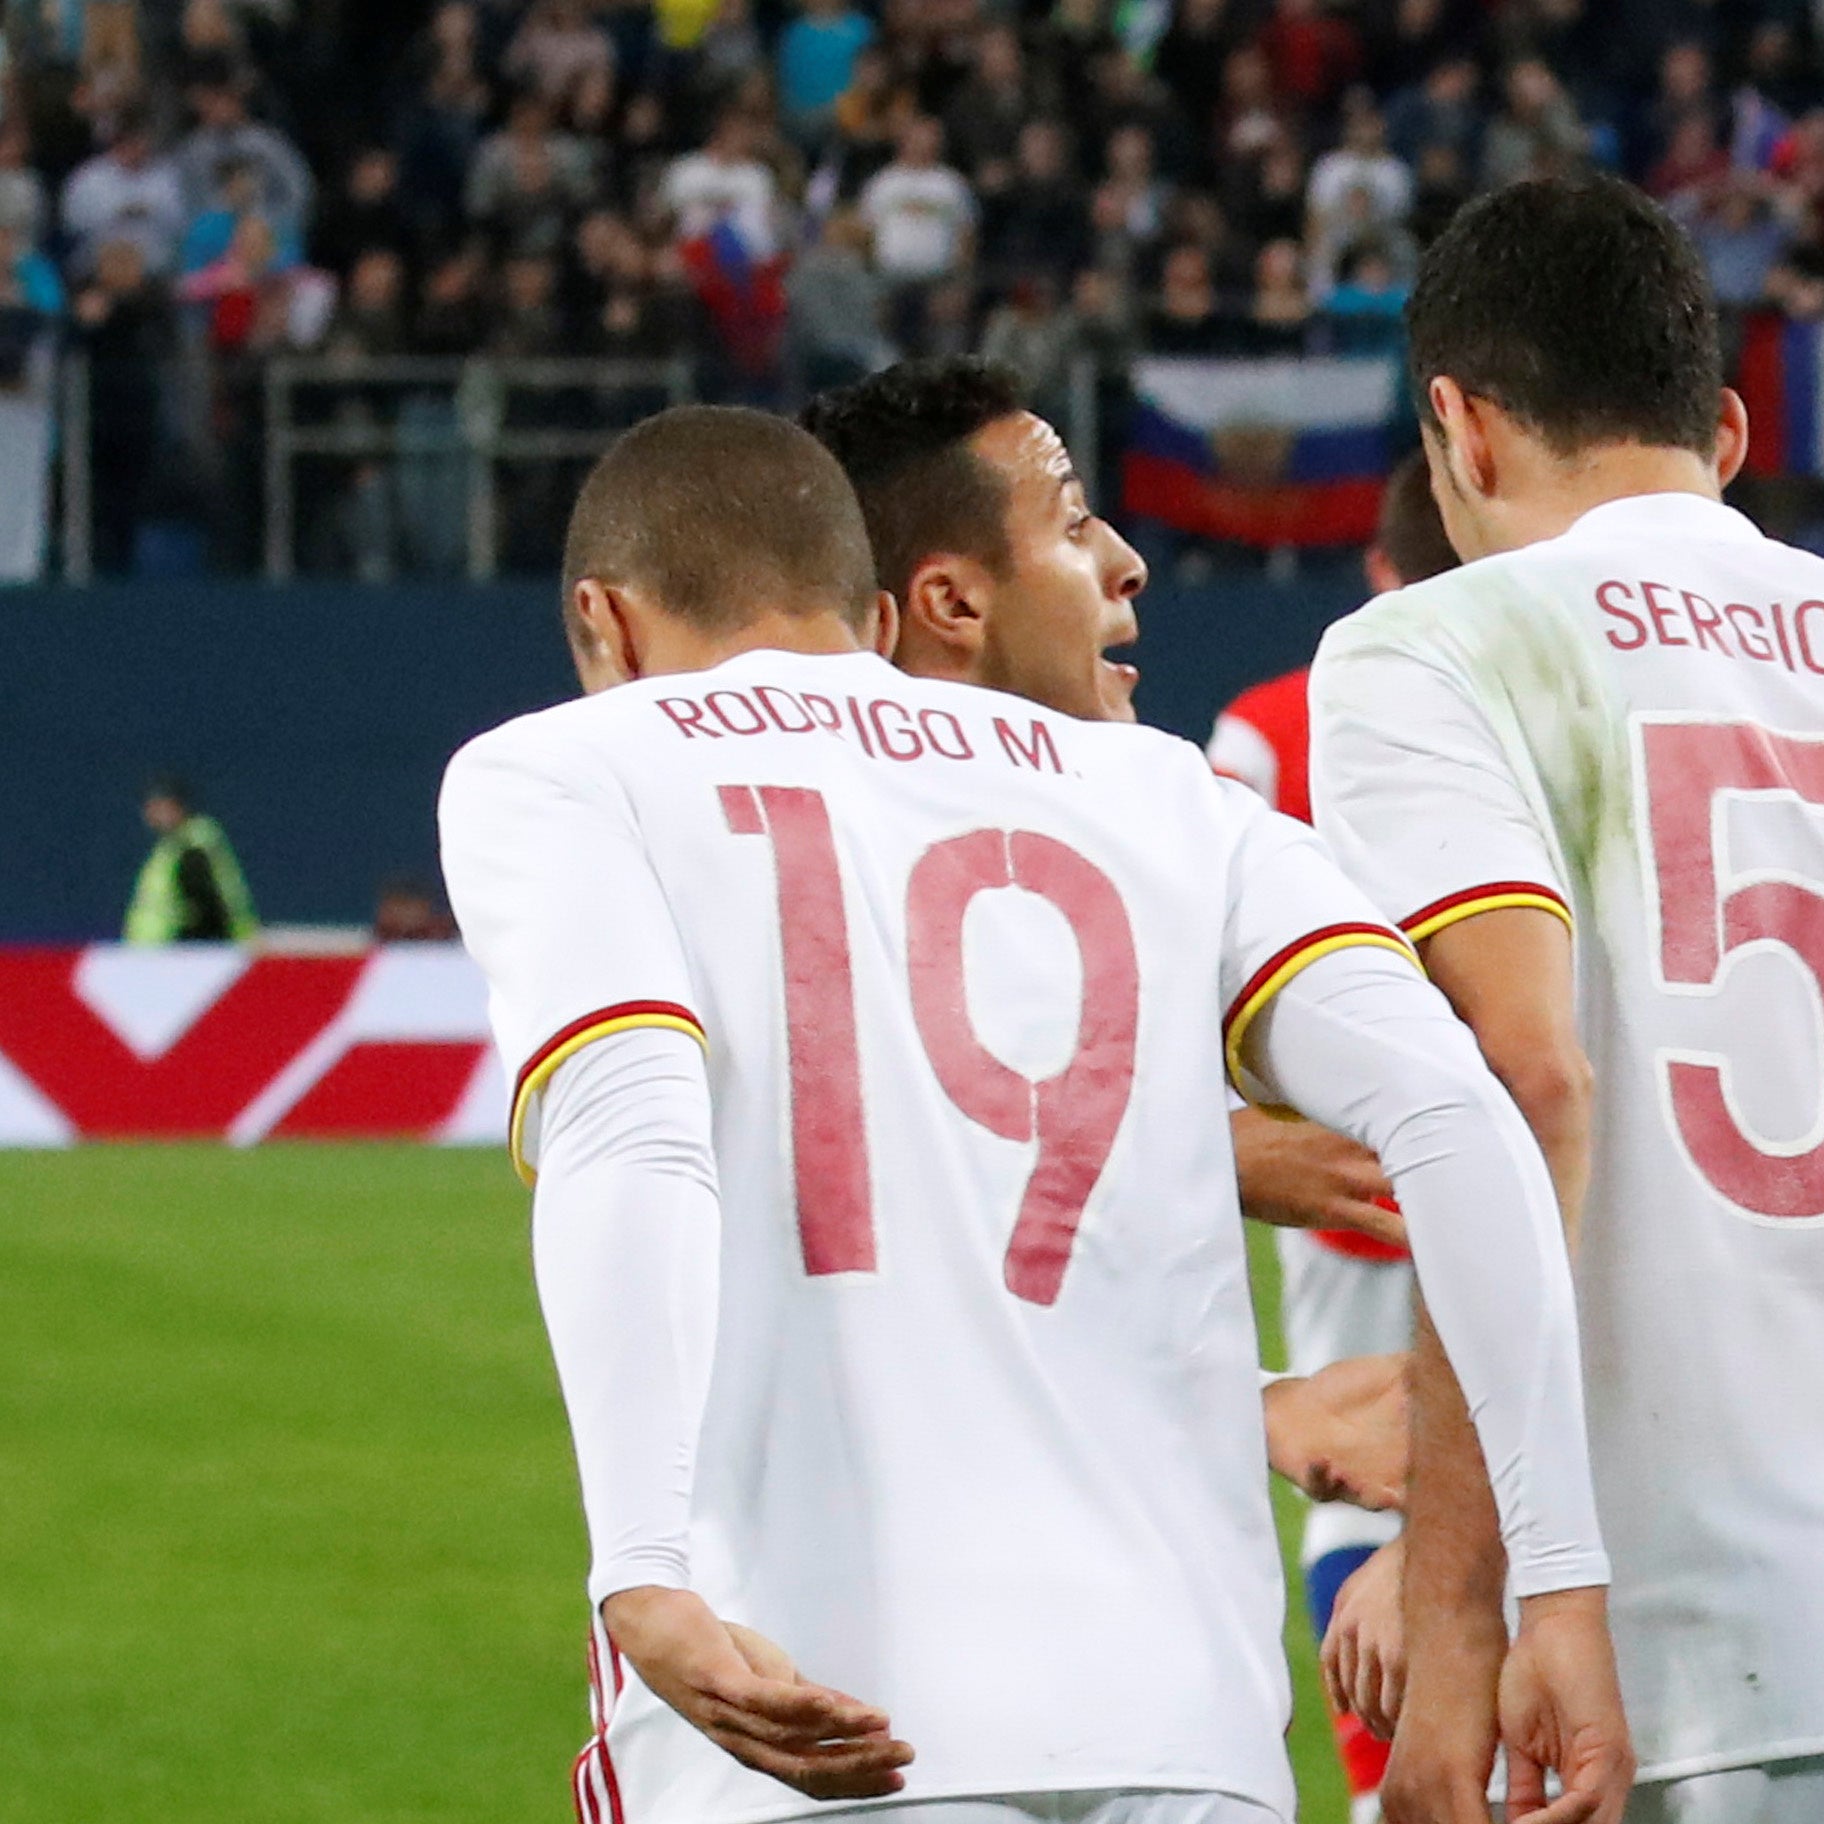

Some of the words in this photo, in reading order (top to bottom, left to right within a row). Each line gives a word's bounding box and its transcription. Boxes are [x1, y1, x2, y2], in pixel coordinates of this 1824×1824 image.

[656, 685, 976, 762] RODRIGO
[992, 716, 1084, 778] M.
[716, 784, 1141, 1307] 19
